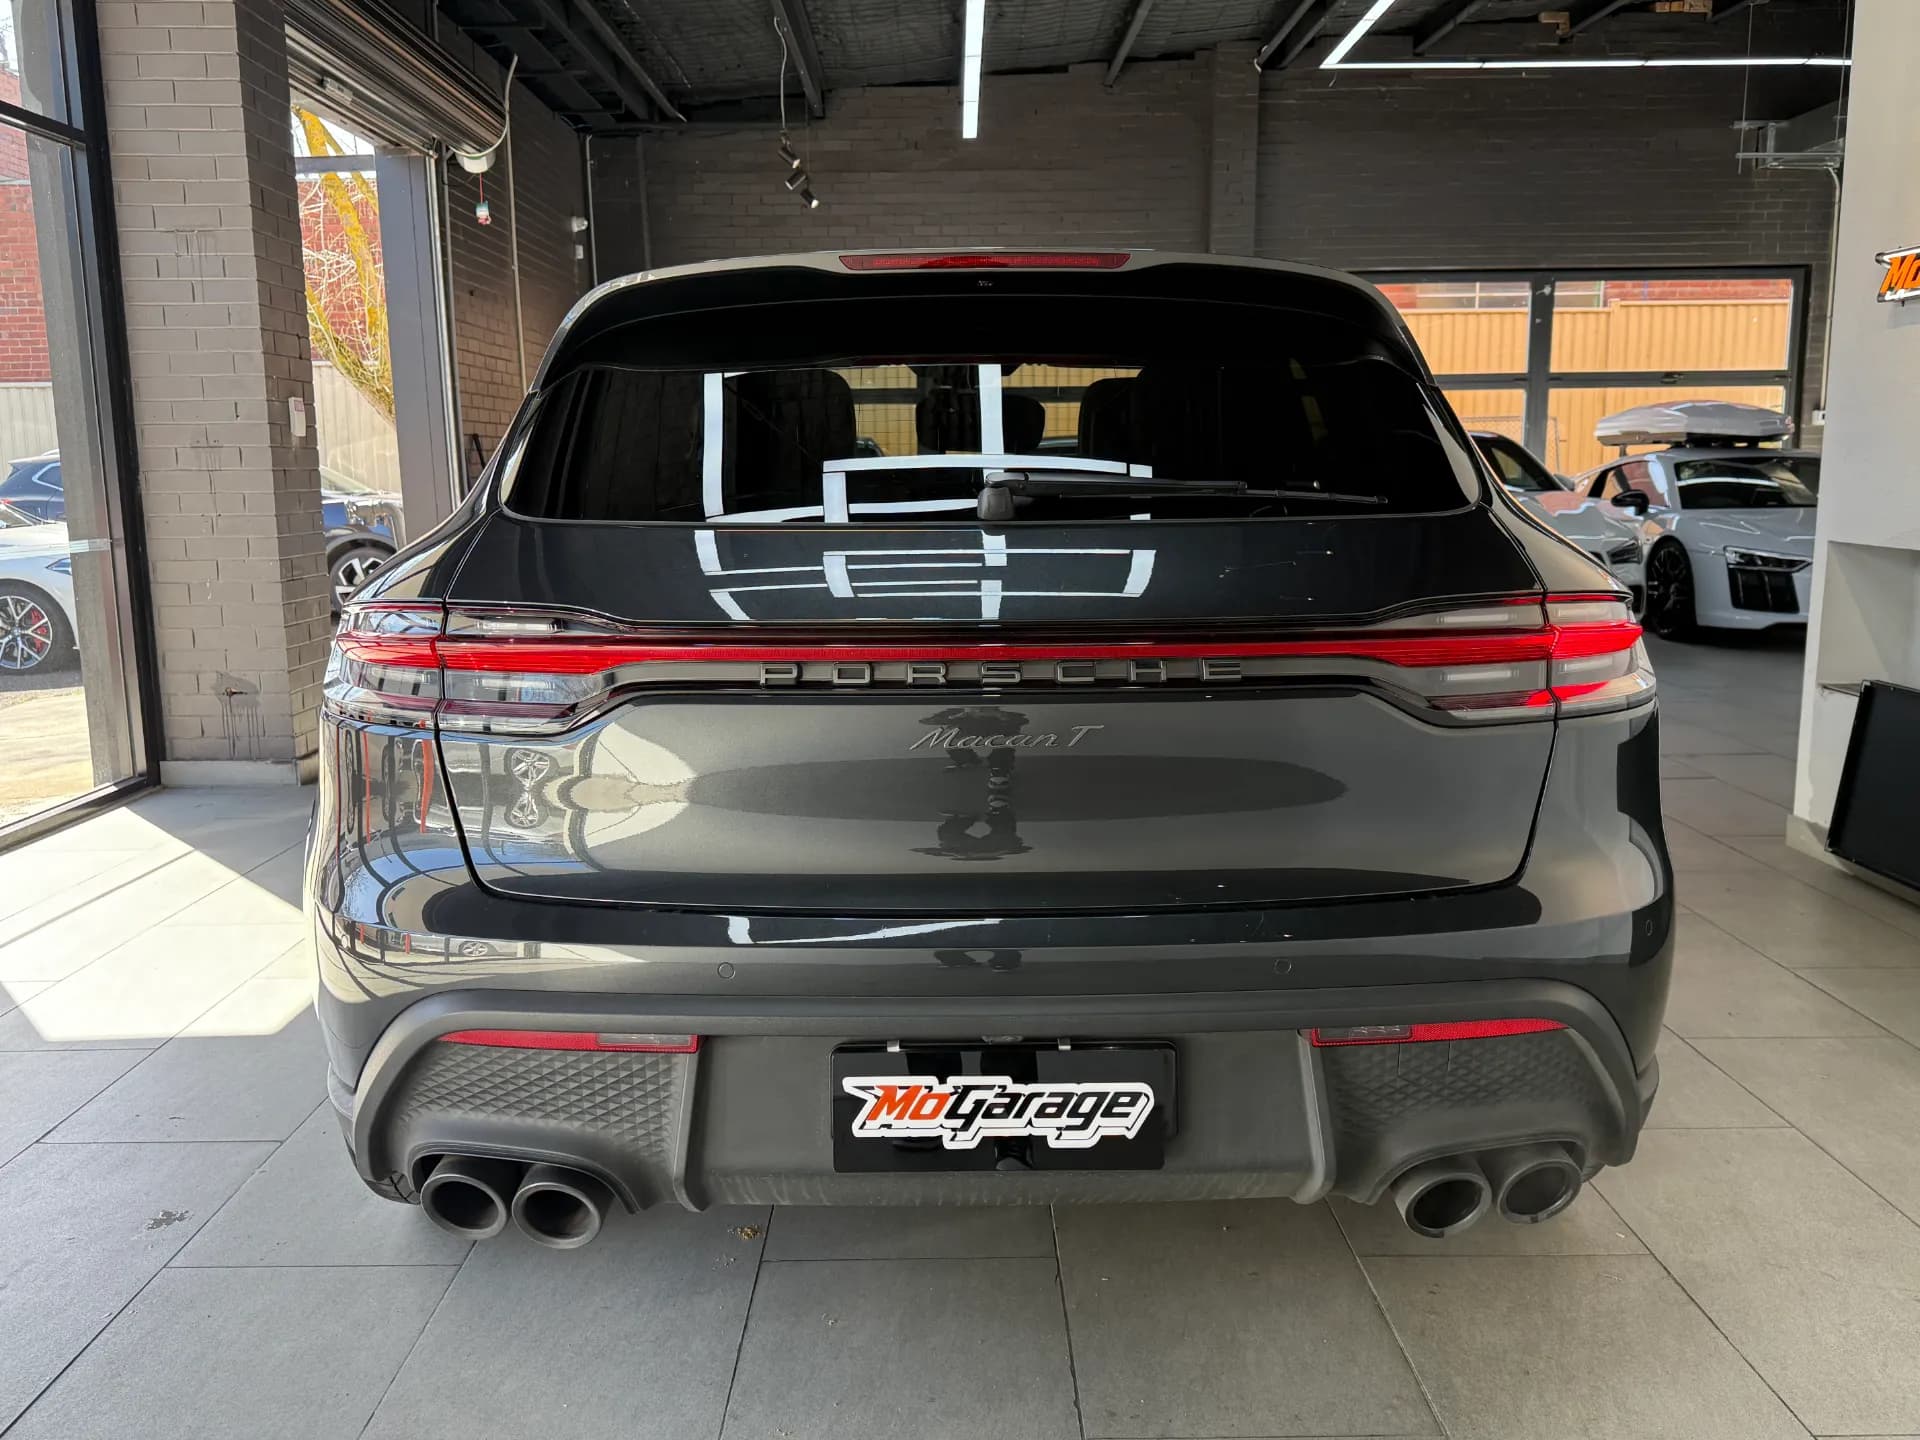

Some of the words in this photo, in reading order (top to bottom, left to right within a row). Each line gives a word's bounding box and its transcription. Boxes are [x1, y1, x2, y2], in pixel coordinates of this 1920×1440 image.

[759, 659, 1242, 685] PORSCHE
[909, 727, 1058, 750] Macan
[1067, 725, 1105, 747] T
[853, 1083, 1150, 1139] MoGarage
